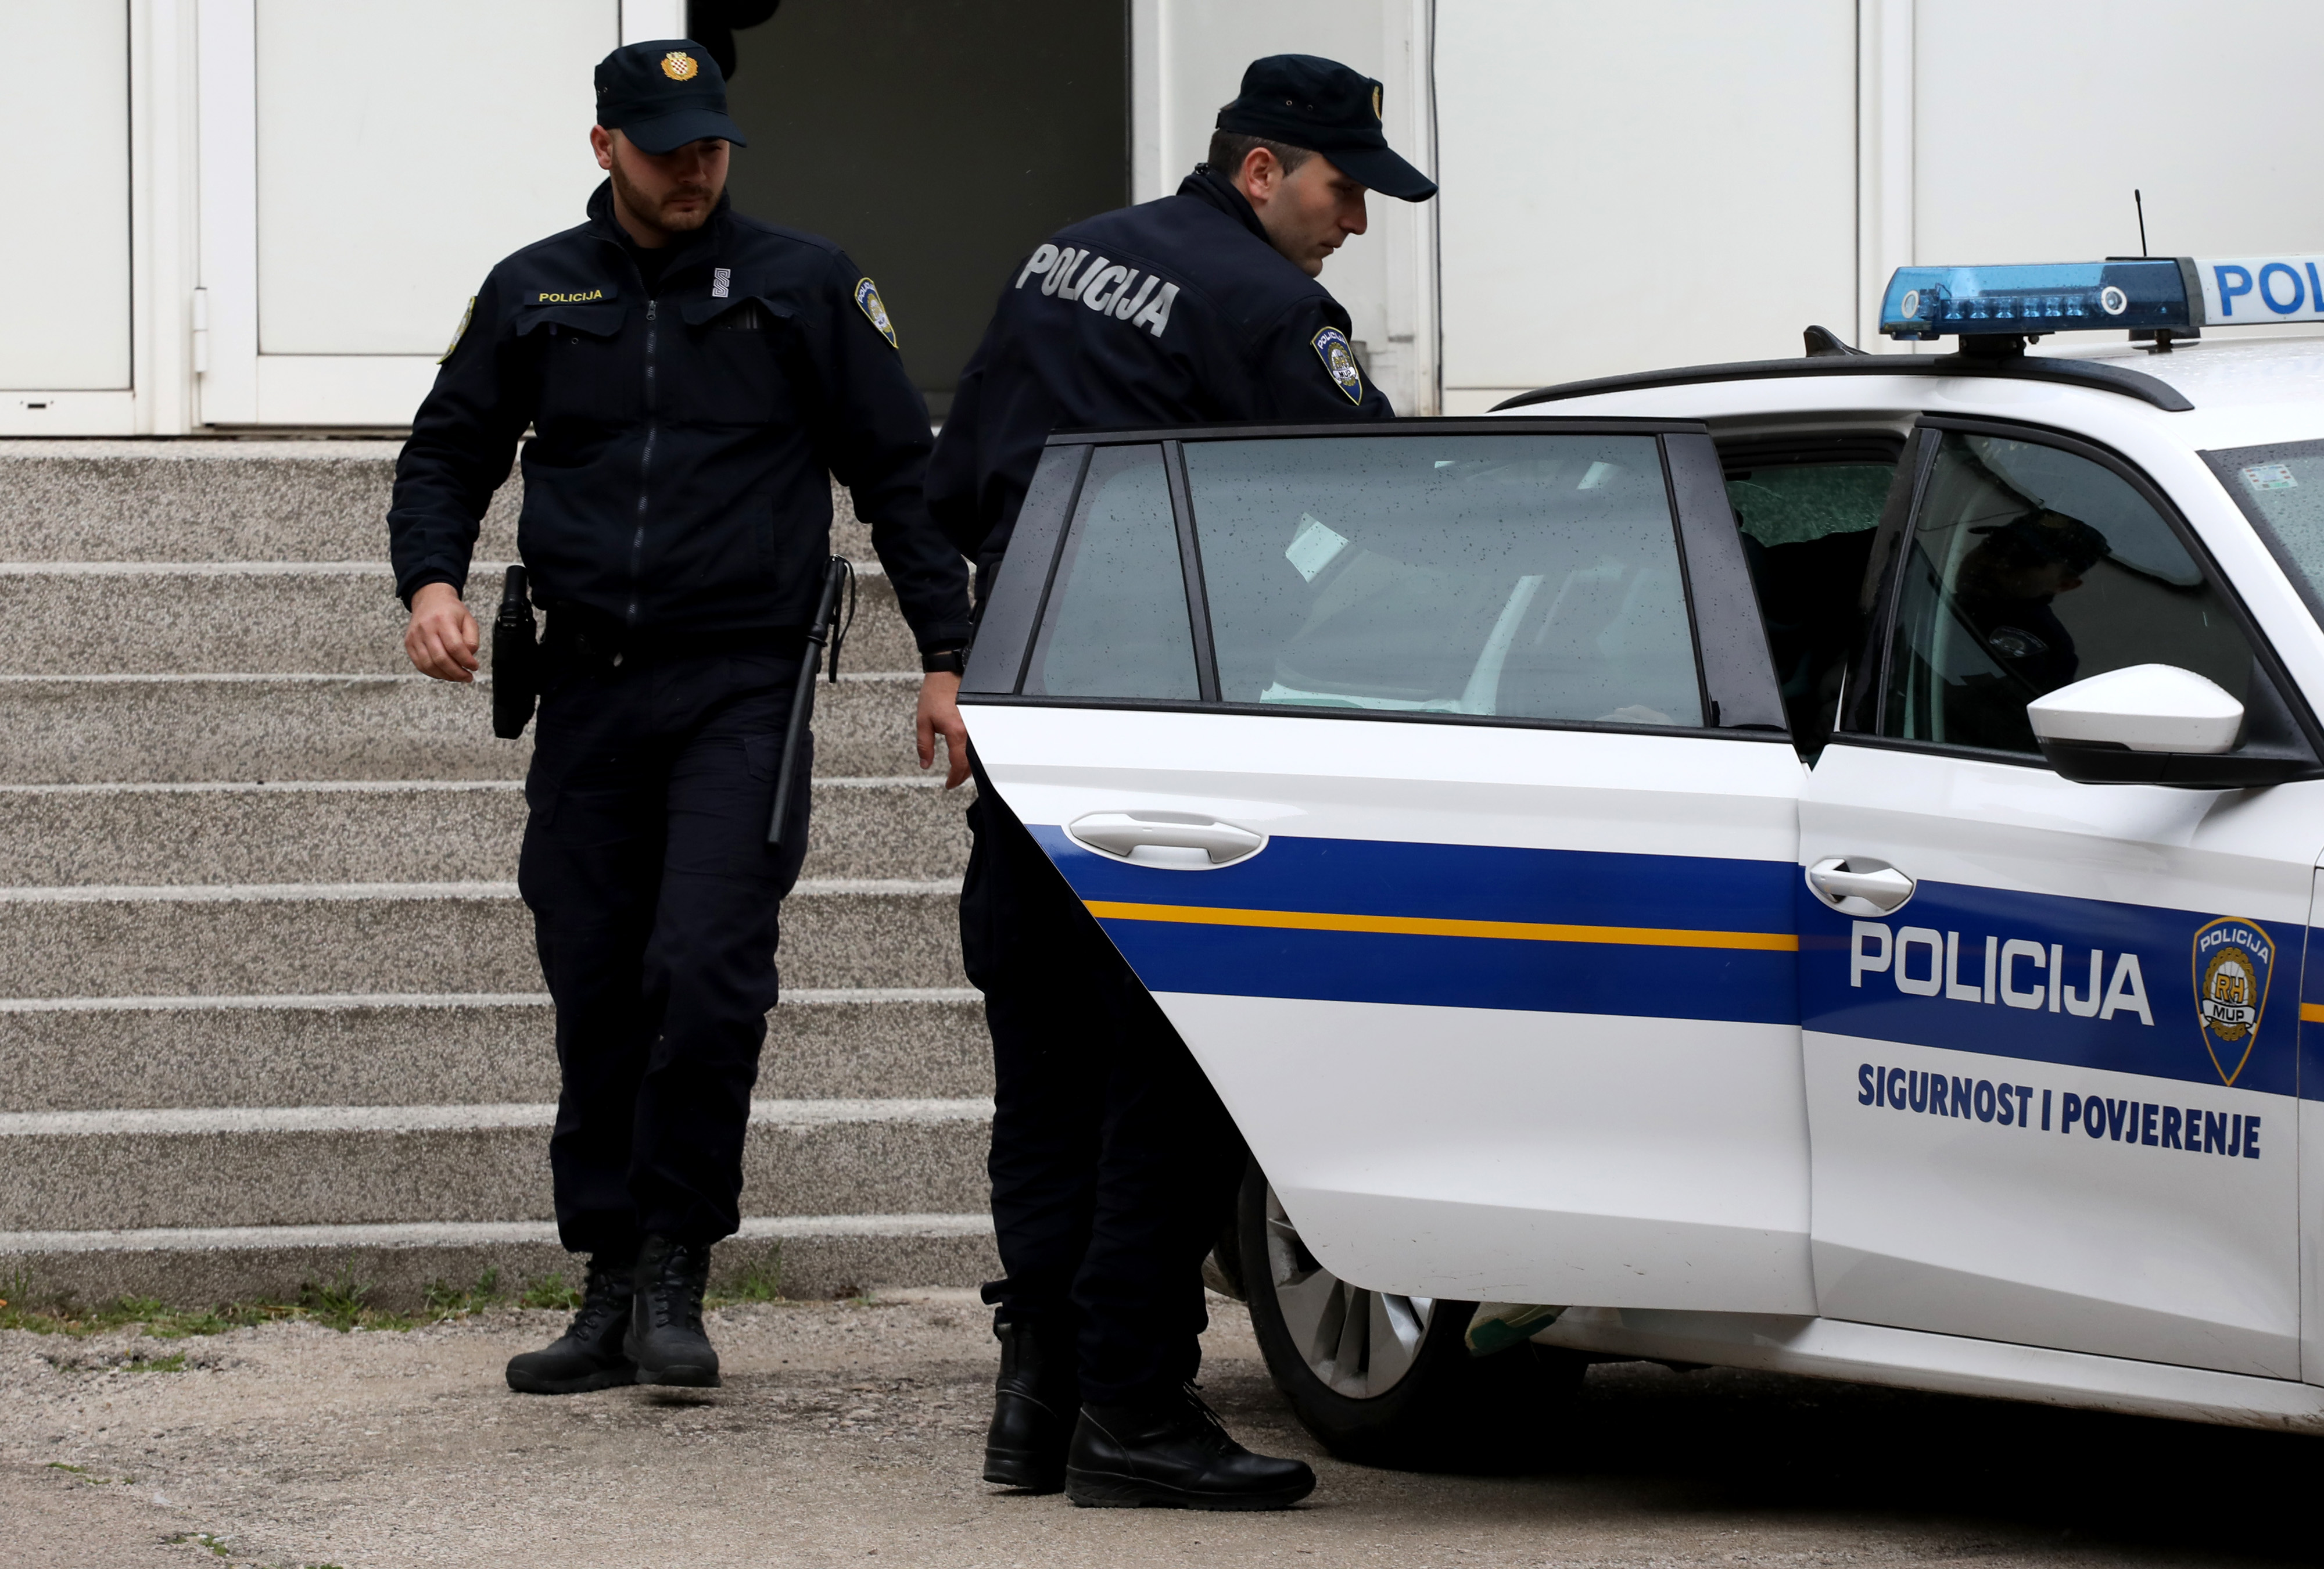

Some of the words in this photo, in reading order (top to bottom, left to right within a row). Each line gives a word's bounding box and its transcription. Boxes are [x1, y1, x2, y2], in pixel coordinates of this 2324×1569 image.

[539, 289, 602, 302] POLICIJA
[1016, 243, 1180, 338] POLICIJA
[1338, 370, 1351, 378] MUP
[2200, 929, 2268, 964] POLICIJA
[1850, 920, 2154, 1026] POLICIJA
[2215, 973, 2244, 1004] RH
[2212, 1004, 2245, 1022] MUP
[1858, 1063, 2033, 1128] SIGURNOST
[2041, 1090, 2052, 1131] I
[2061, 1092, 2262, 1160] POVJERENJE
